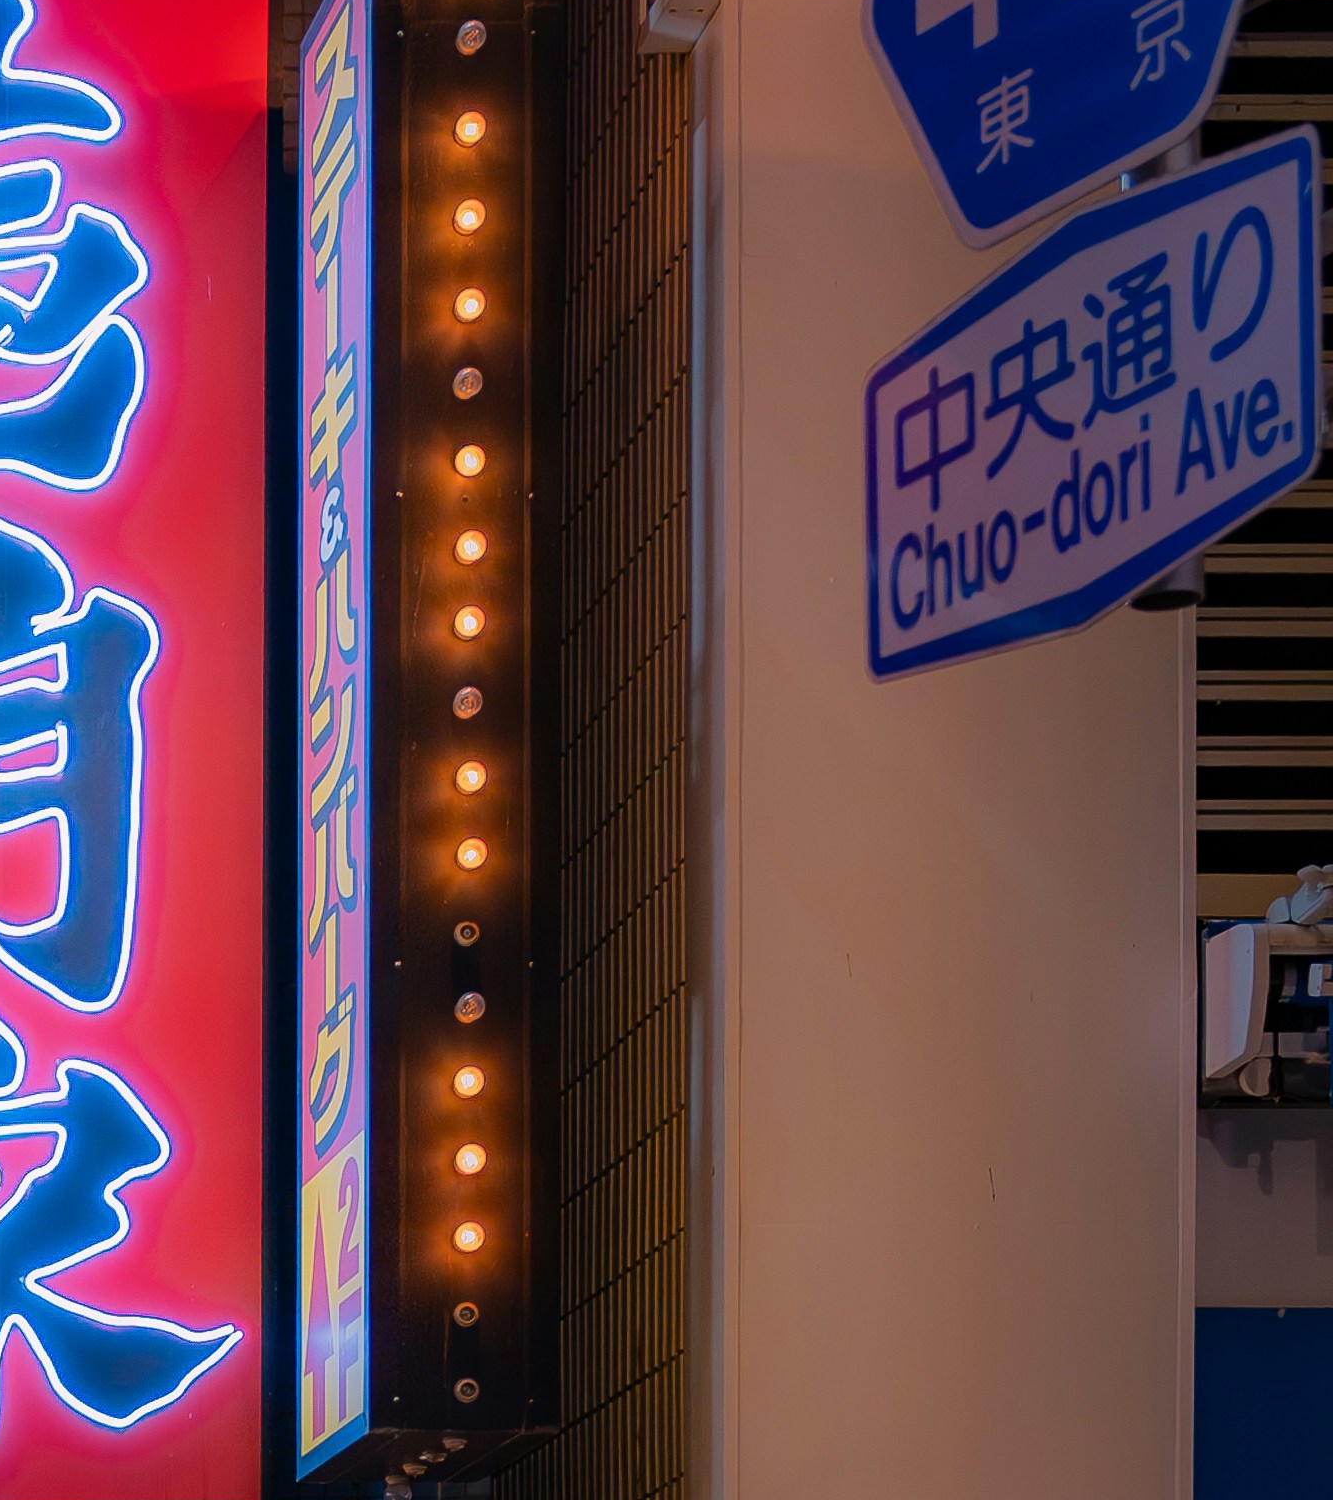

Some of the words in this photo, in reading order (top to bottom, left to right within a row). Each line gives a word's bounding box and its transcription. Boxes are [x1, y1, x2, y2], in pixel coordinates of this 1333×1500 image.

[894, 203, 1274, 513] 中央通り
[889, 414, 1150, 630] Chuo-dori
[1175, 377, 1292, 497] Ave.
[337, 1157, 361, 1424] 2F
